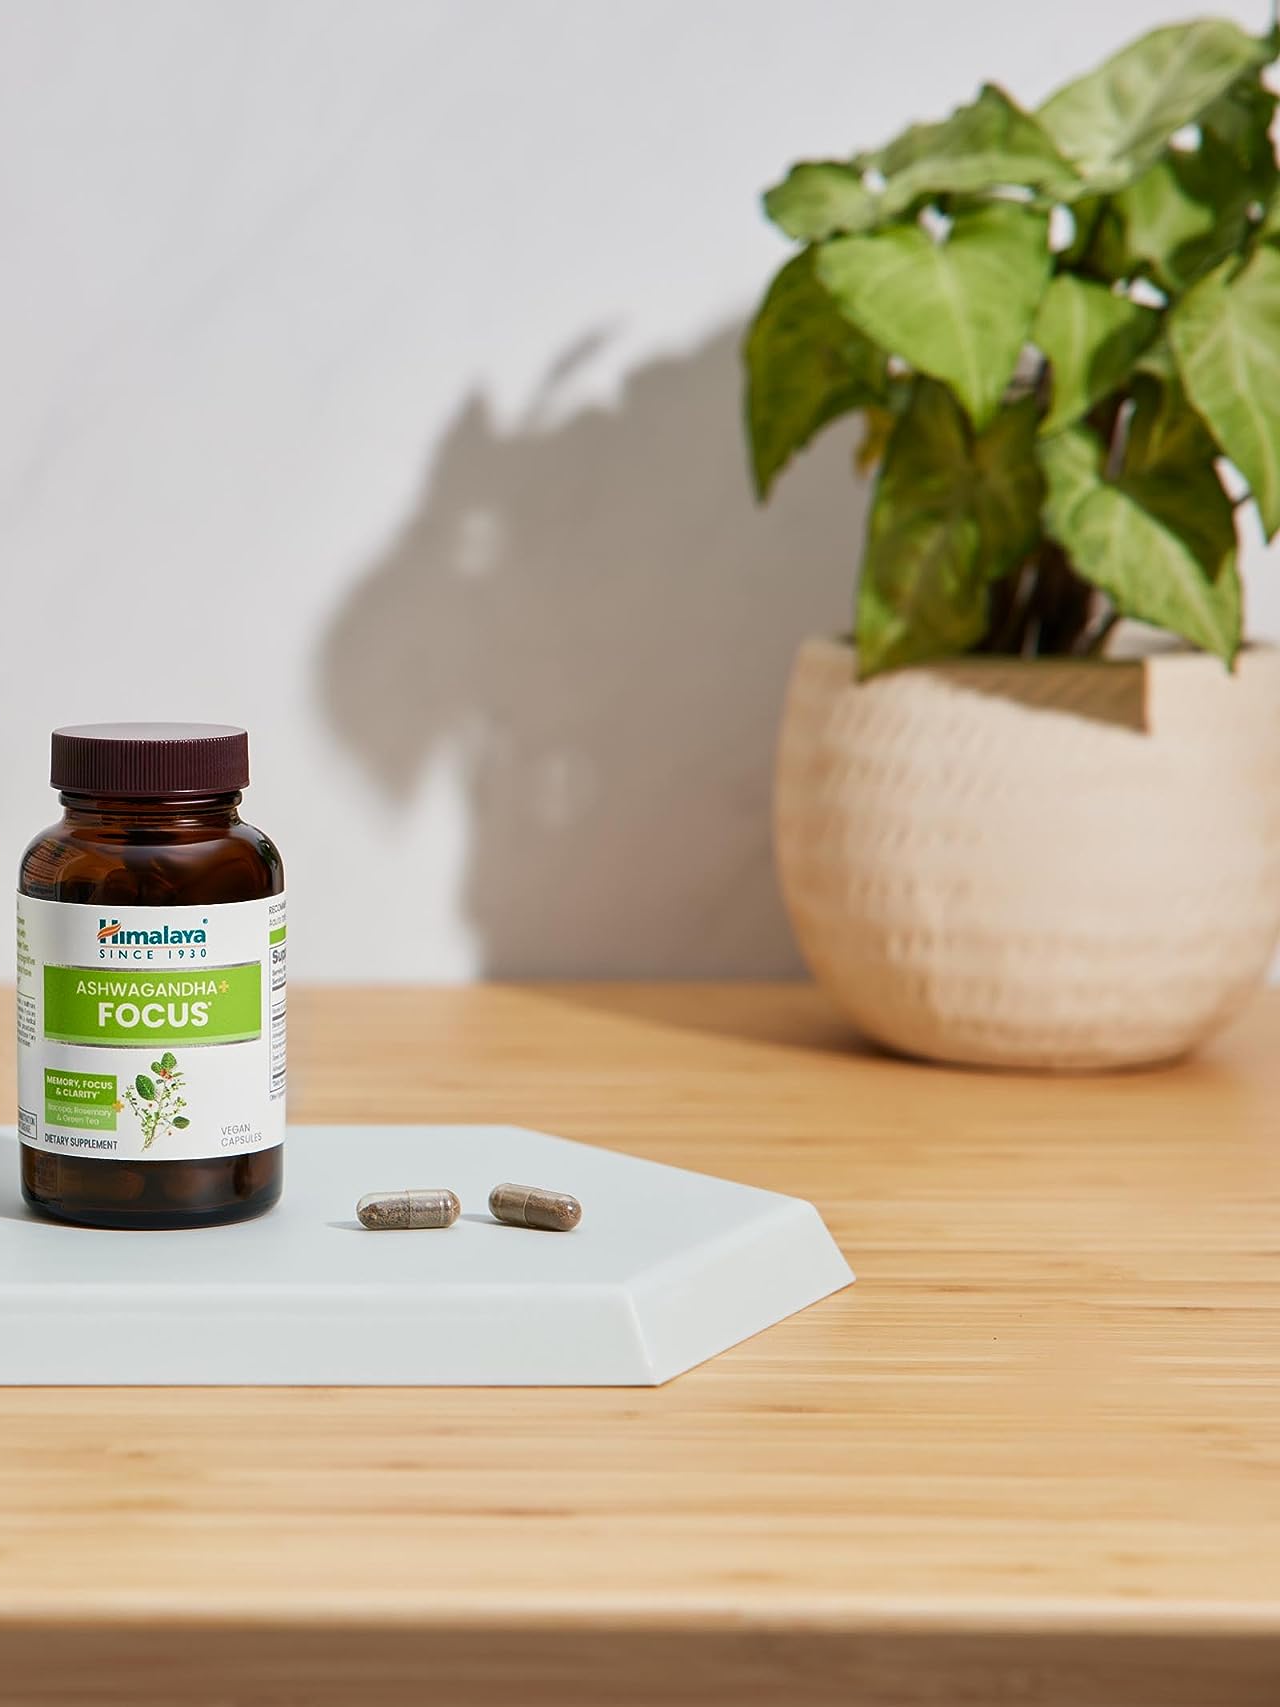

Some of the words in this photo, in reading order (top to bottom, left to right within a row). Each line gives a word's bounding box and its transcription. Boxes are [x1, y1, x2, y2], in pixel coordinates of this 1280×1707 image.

[100, 949, 153, 960] SINCE
[168, 948, 207, 960] 1930
[46, 1075, 82, 1089] MEMORY,
[82, 1080, 114, 1091] FOCUS
[55, 1087, 62, 1096] &
[86, 1116, 100, 1126] Tea
[220, 1123, 251, 1136] VEGAN
[45, 1133, 70, 1147] DIETARY
[70, 1137, 118, 1150] SUPPLEMENT
[221, 1132, 262, 1147] CAPSULES
